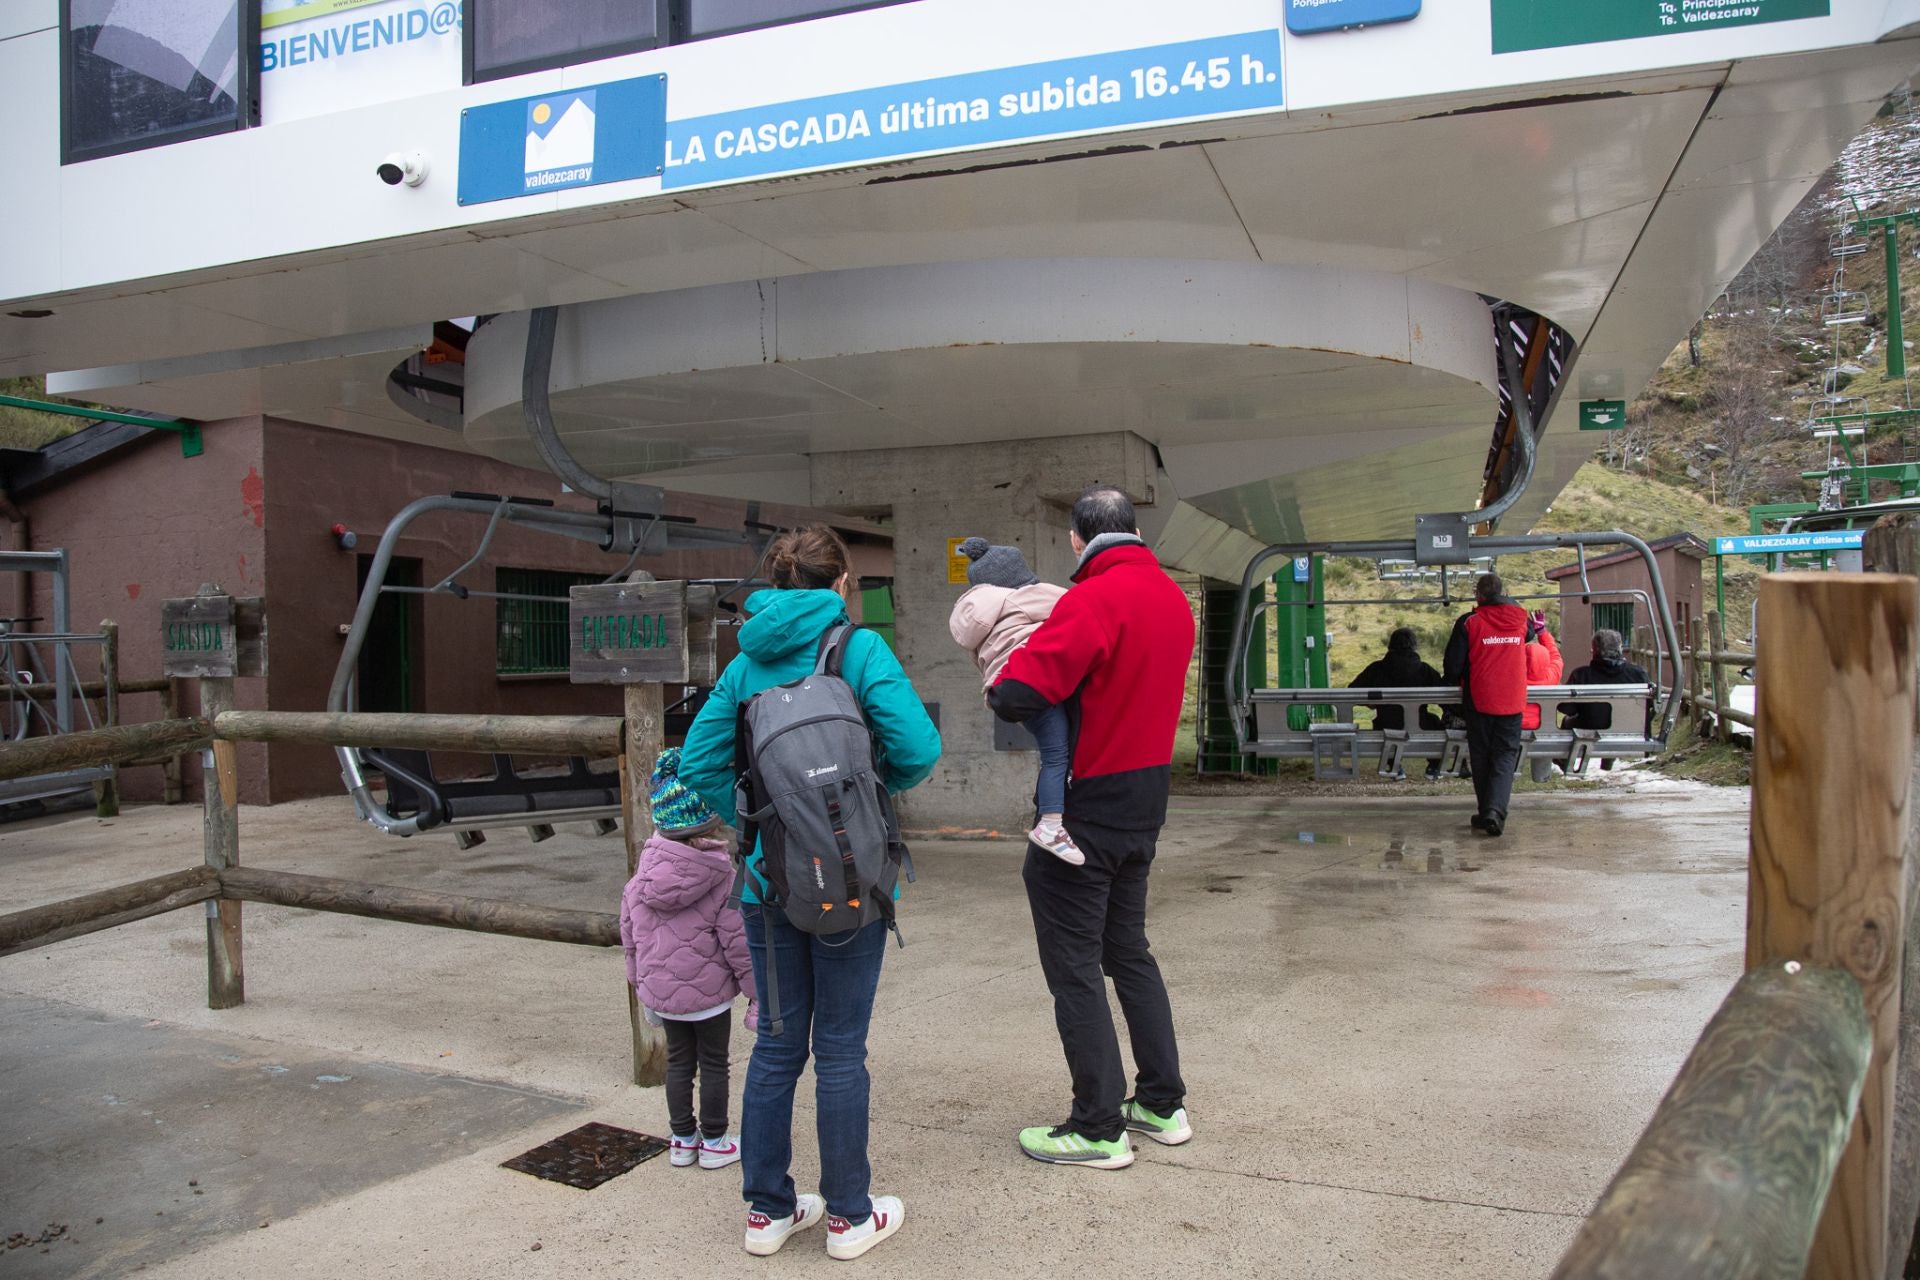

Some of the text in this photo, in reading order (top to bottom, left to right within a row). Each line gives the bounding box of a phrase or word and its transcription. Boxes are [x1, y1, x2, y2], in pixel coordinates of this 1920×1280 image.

[1659, 0, 1765, 14] Tq. Principian
[1659, 6, 1760, 26] Ts. Valdezcaray
[665, 54, 1277, 168] LA CASCADA última subida 16.45 h.
[525, 167, 592, 188] valdezcaray
[1743, 537, 1811, 548] VALDEZCARAY
[1813, 535, 1843, 545] última
[168, 623, 223, 651] SALIDA
[582, 613, 668, 650] ENTRADA
[1482, 636, 1521, 646] valdezcaray
